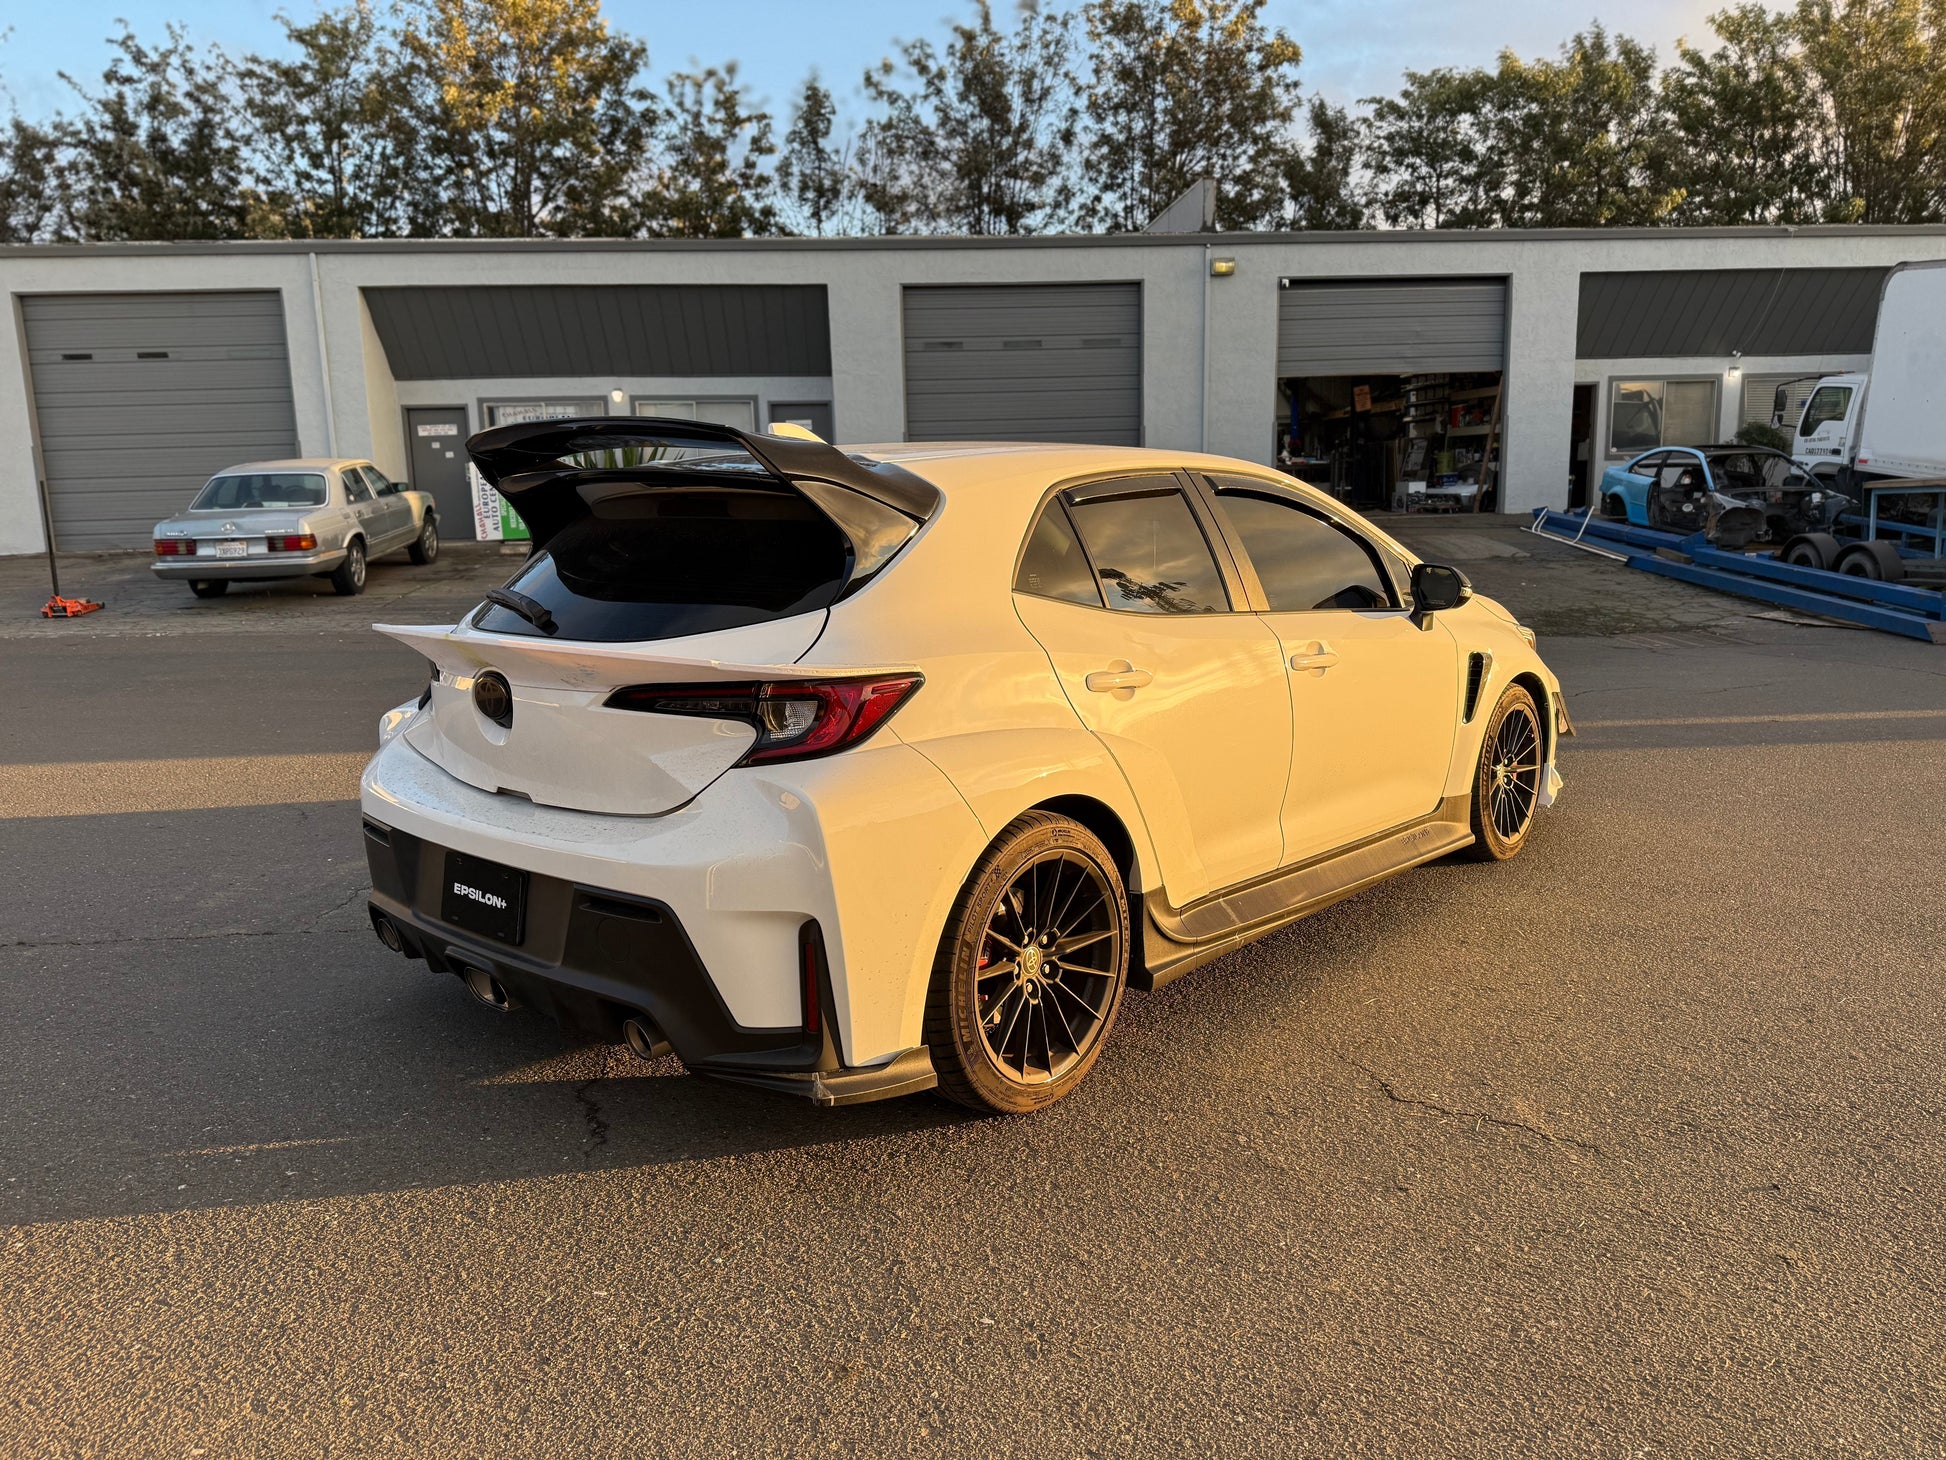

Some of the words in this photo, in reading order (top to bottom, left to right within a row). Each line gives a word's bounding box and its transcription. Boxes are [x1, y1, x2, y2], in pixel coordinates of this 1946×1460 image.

[489, 484, 498, 503] CEN
[491, 506, 501, 532] AUTO
[453, 882, 507, 909] EPSILON+
[967, 909, 981, 935] PILOT
[977, 882, 994, 909] SPORT
[958, 946, 972, 1043] MICHELIN
